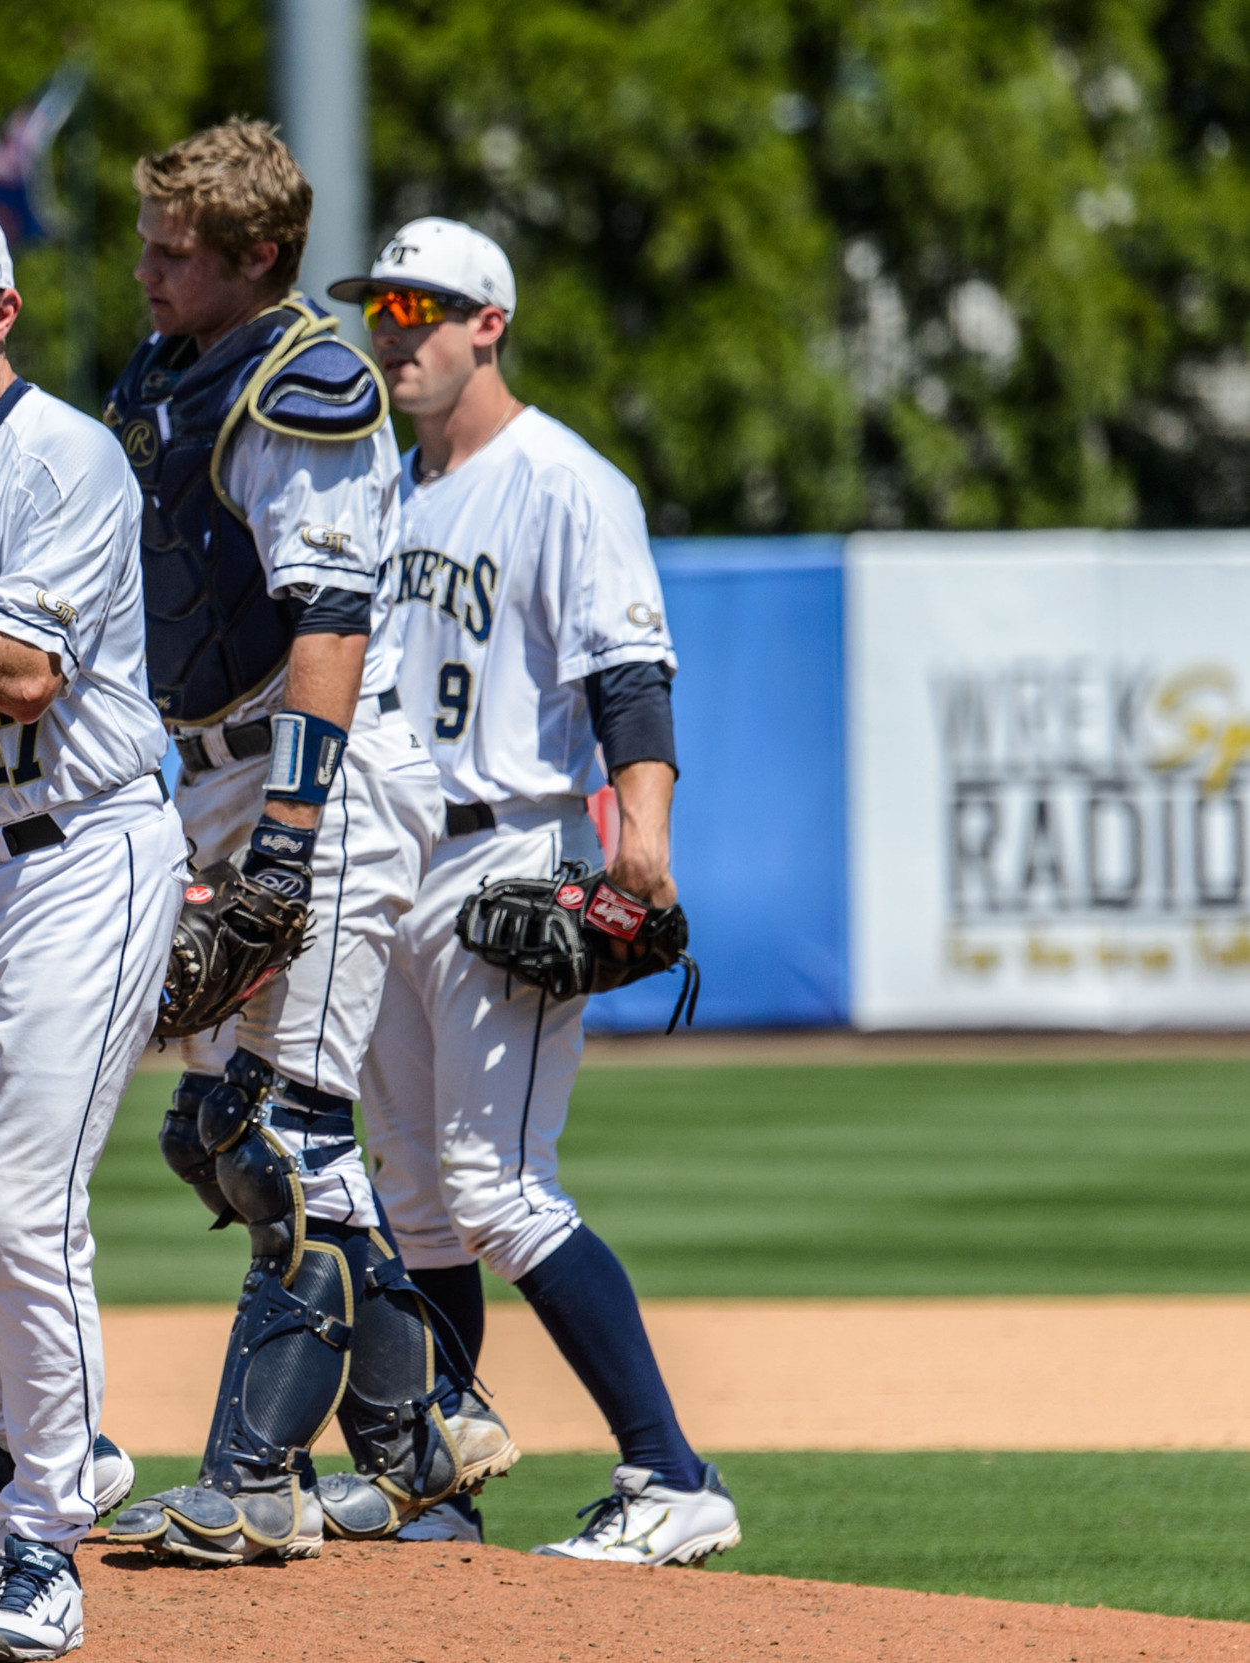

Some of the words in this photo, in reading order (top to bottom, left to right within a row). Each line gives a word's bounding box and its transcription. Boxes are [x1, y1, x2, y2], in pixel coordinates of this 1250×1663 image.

[301, 524, 352, 554] GT
[36, 589, 80, 627] GT
[376, 549, 499, 645] KETS
[433, 661, 474, 745] 9
[946, 775, 1248, 920] RADIO
